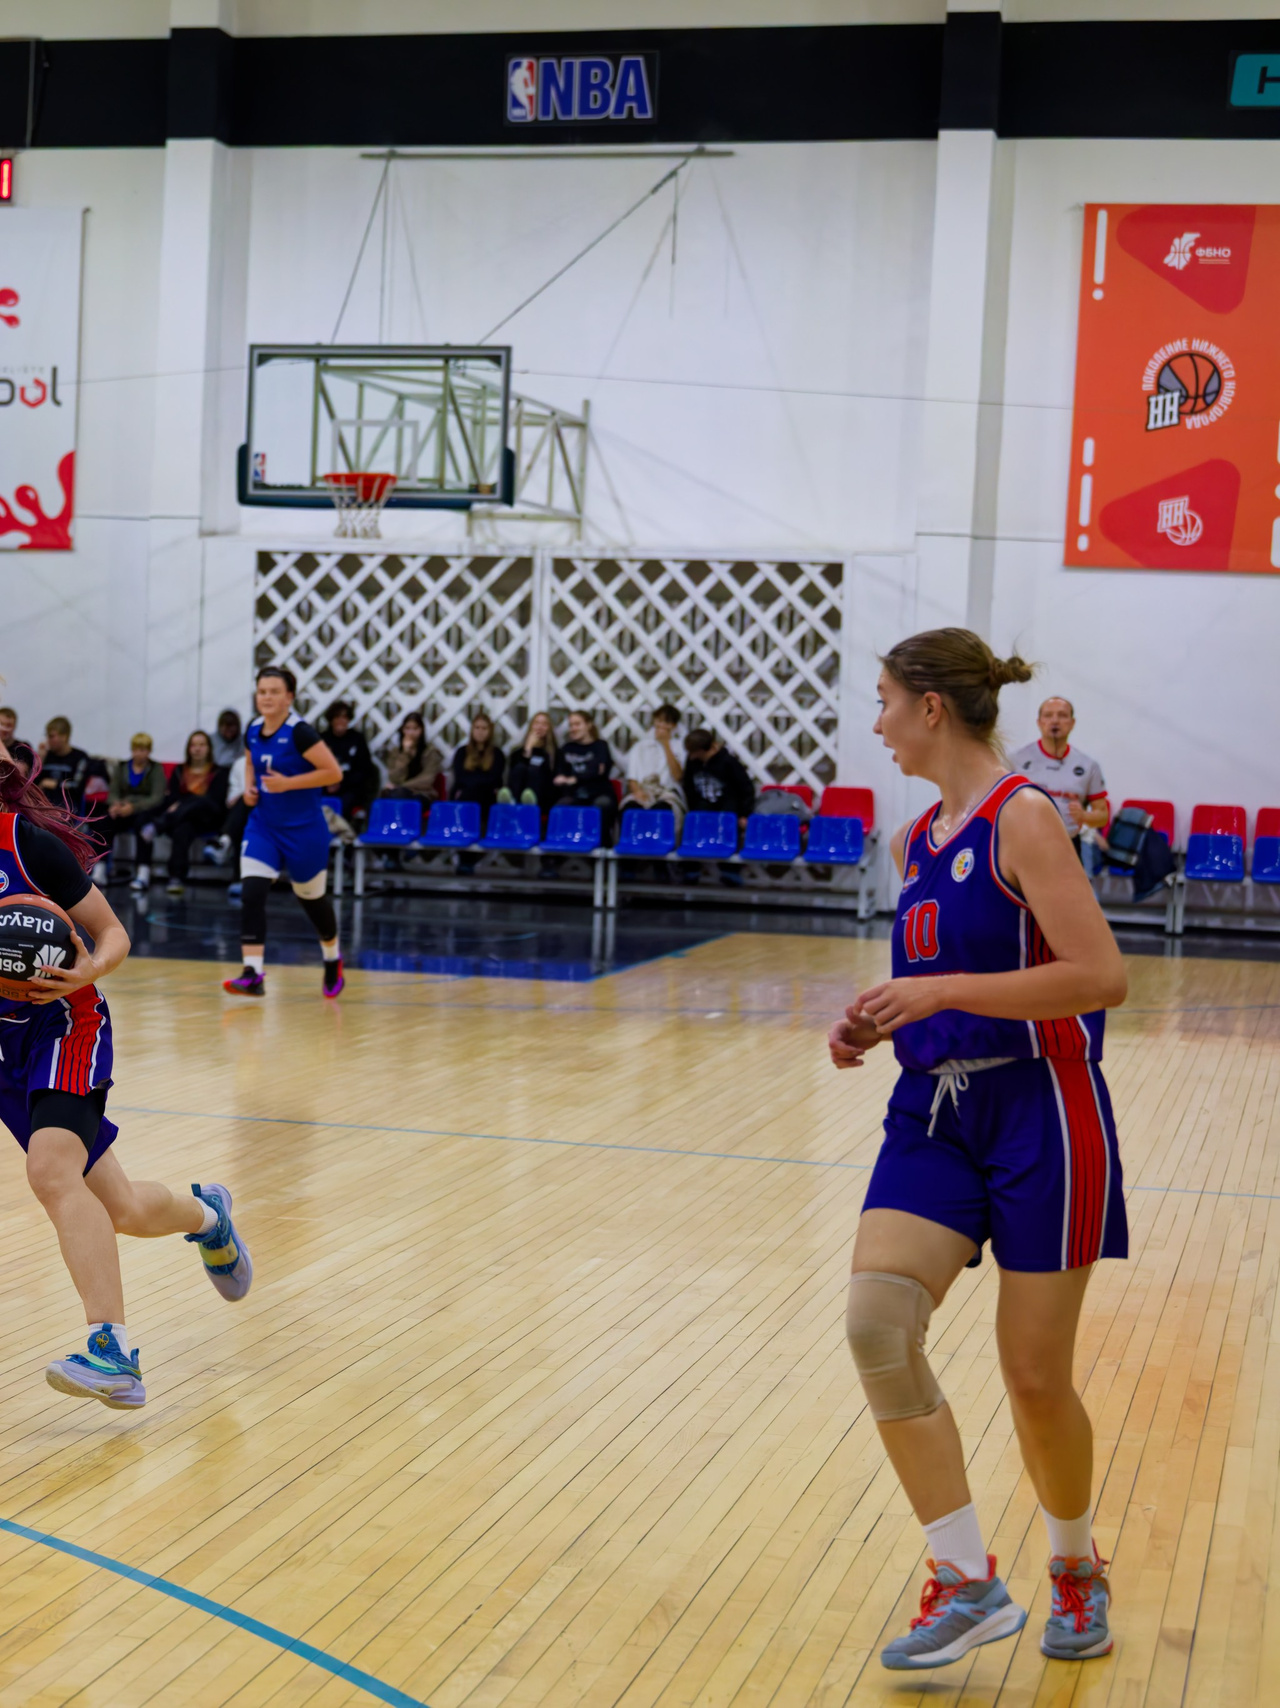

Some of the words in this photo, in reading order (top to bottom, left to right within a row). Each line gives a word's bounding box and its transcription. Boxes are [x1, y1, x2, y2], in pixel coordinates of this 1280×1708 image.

[536, 55, 653, 121] NBA
[1195, 247, 1231, 258] ФБНО
[1142, 338, 1188, 391] ПОКОЛЕНИЕ
[1191, 338, 1236, 379] НИЖНЕГО
[901, 899, 940, 963] 10
